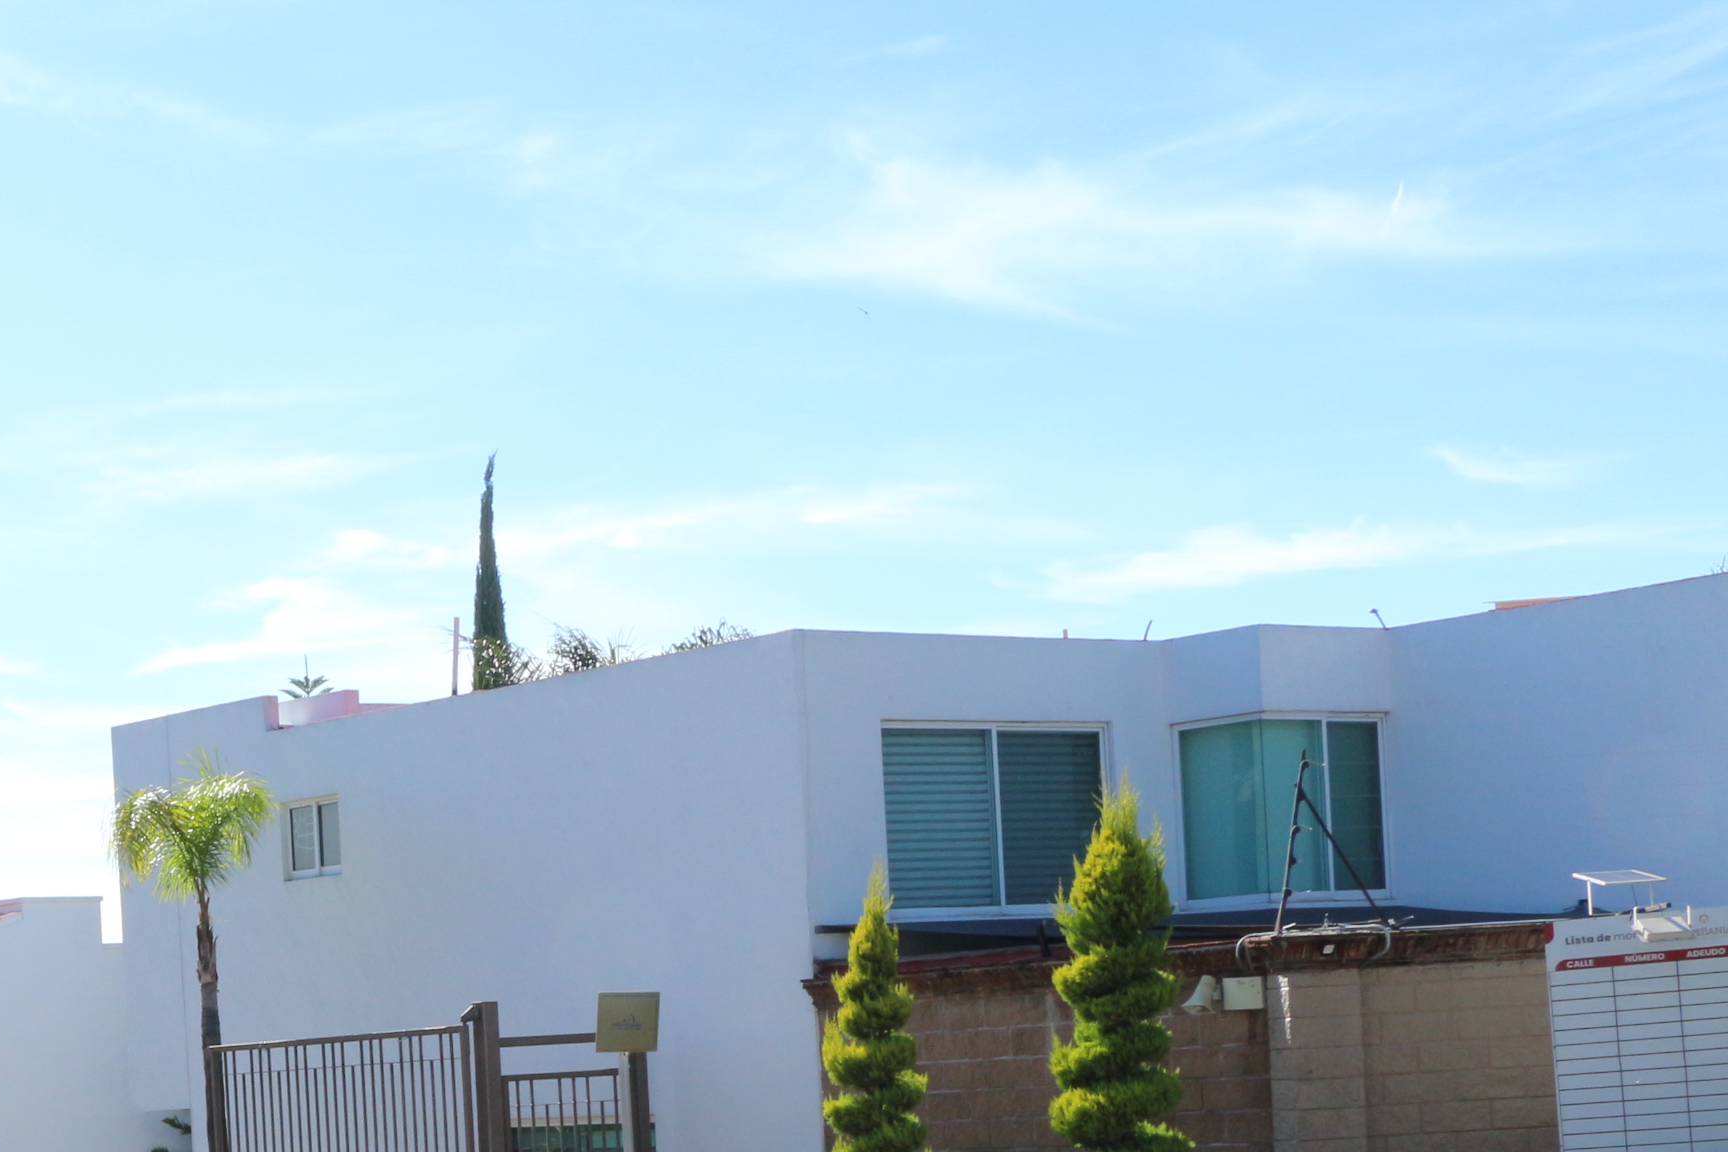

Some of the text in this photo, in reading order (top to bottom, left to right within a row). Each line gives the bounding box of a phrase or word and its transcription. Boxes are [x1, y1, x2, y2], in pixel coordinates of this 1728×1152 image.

[1565, 935, 1594, 946] Lista
[1596, 933, 1611, 943] de
[1566, 947, 1726, 969] CALLE NÚMERO ADEUDO
